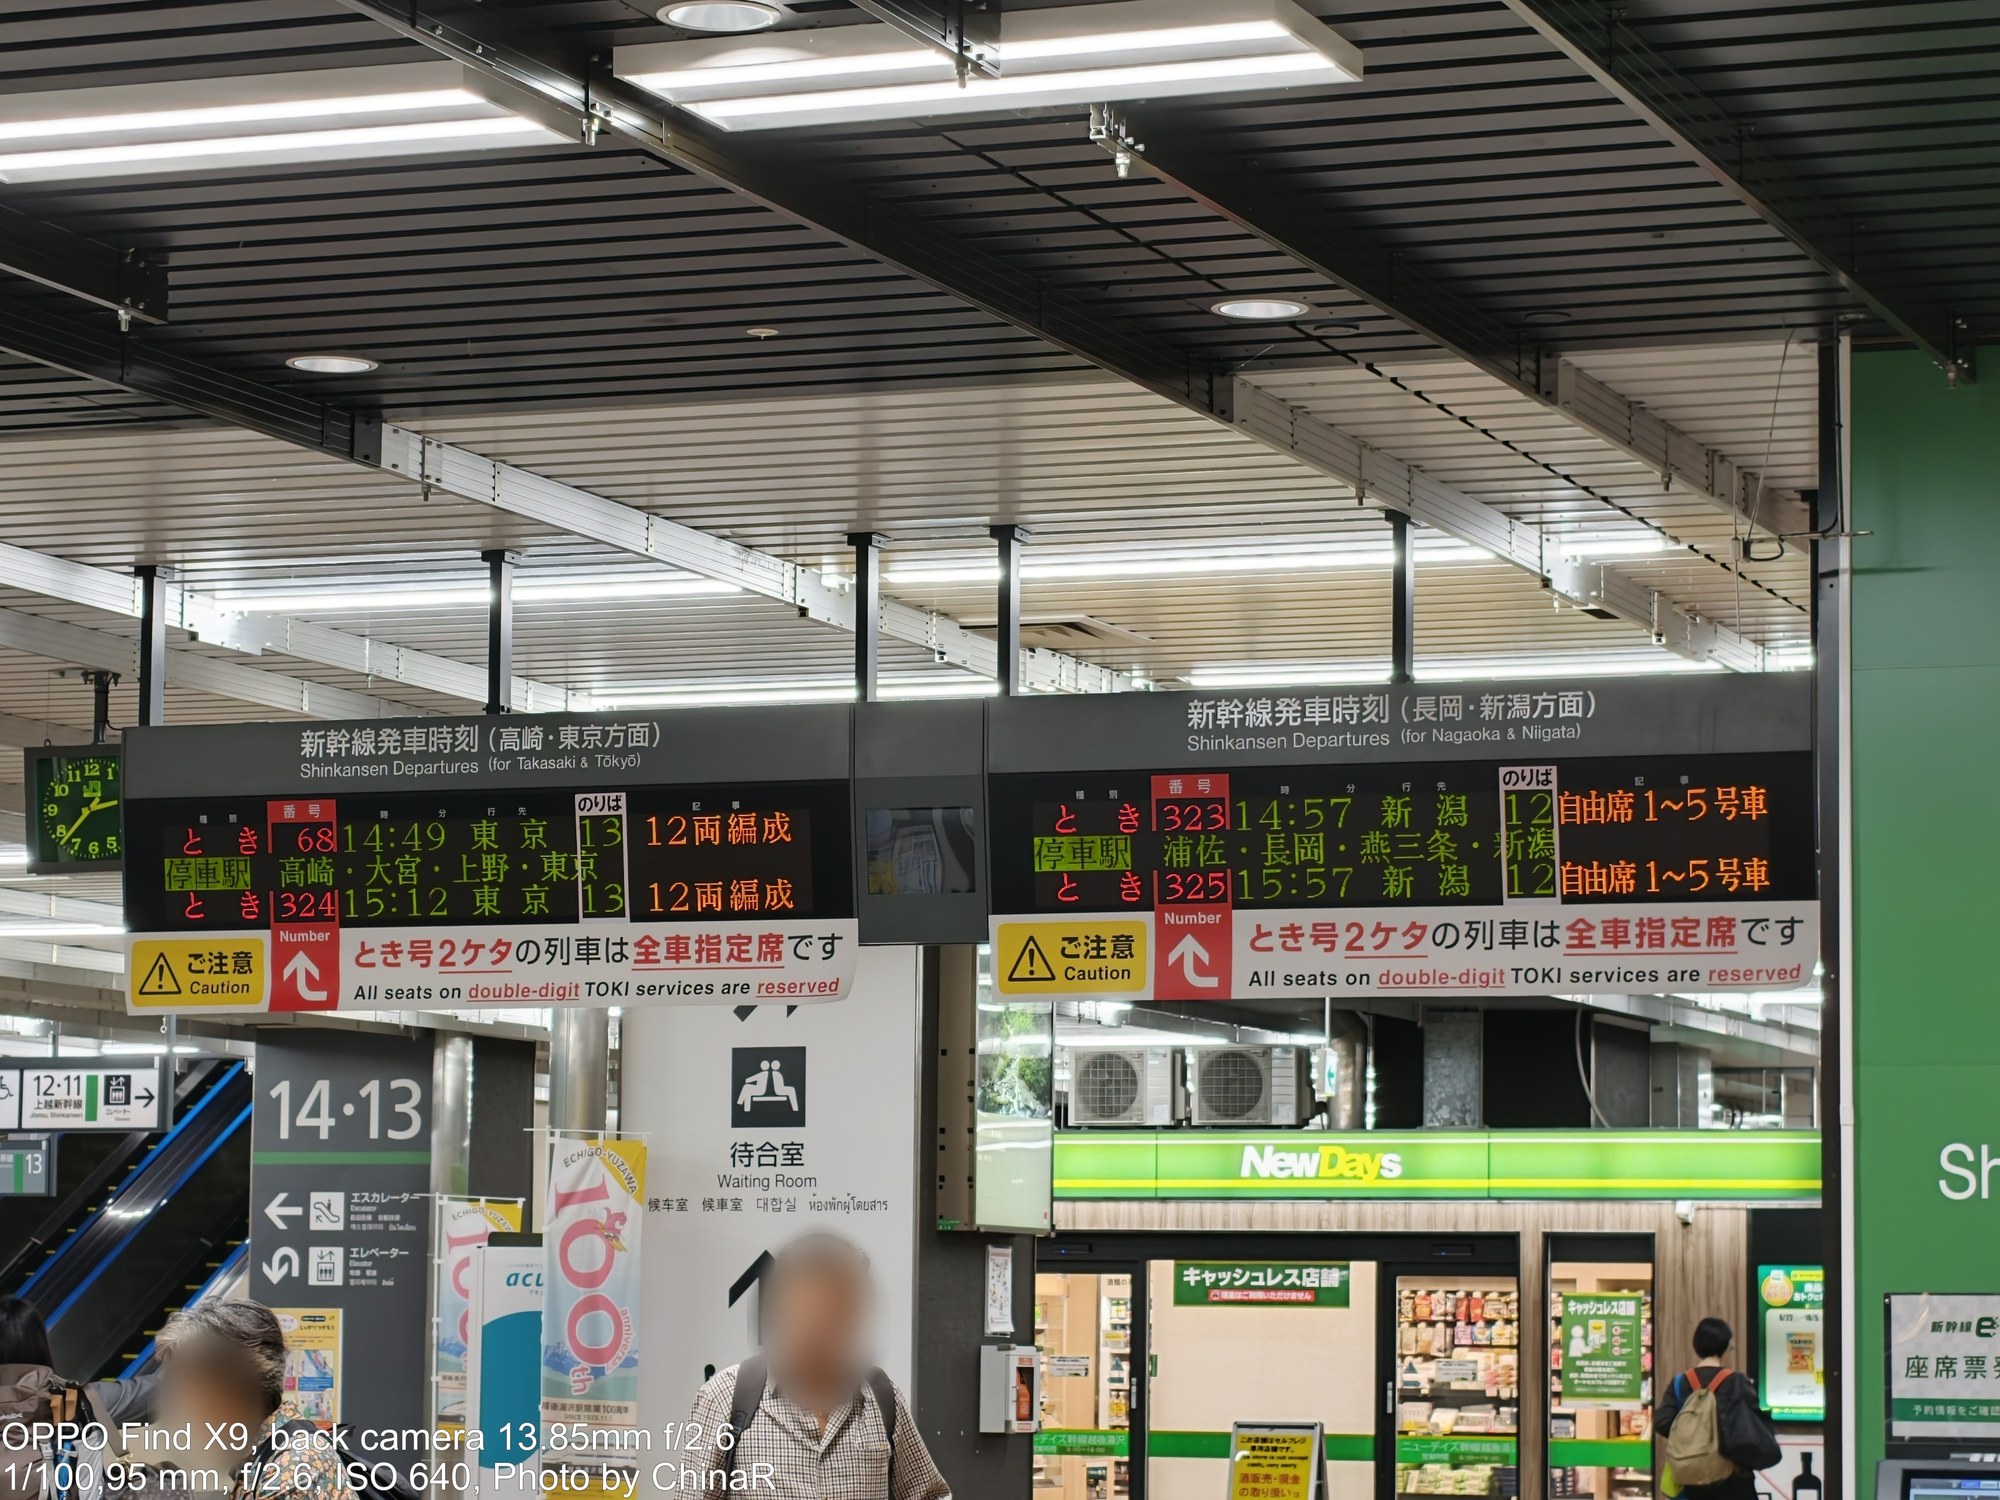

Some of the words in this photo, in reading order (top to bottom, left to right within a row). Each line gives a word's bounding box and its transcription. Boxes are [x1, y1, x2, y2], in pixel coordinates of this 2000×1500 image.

[1188, 694, 1389, 729] 新幹線発車時刻
[301, 724, 478, 758] 新幹線発車時刻
[1188, 735, 1287, 751] Shinkansen
[1293, 732, 1389, 750] Departures
[1401, 729, 1426, 744] (for
[1432, 727, 1501, 744] Nagaoka
[1507, 727, 1515, 740] &
[1522, 725, 1582, 742] Niigata)
[84, 763, 100, 776] 12
[107, 768, 114, 780] 1
[301, 761, 388, 778] Shinkansen
[393, 759, 478, 777] Departures
[488, 757, 510, 772] (for
[517, 756, 576, 770] Takasaki
[580, 757, 588, 768] &
[595, 753, 641, 771] Tōkyō)
[67, 770, 81, 782] 11
[1503, 768, 1552, 786] のりば
[54, 784, 69, 797] 10
[47, 804, 58, 817] 9
[578, 795, 622, 812] のりば
[1163, 804, 1225, 831] 323
[1236, 798, 1352, 831] 14:57
[1506, 793, 1552, 825] 12
[56, 824, 66, 837] 8
[297, 827, 334, 853] 68
[343, 822, 446, 853] 14:49
[580, 818, 622, 848] 13
[646, 811, 792, 846] 12両編成
[71, 838, 82, 850] 7
[88, 841, 99, 854] 6
[106, 836, 117, 849] 5
[1035, 837, 1130, 871] 停車駅
[166, 857, 250, 890] 停車駅
[1165, 873, 1226, 900] 325
[1238, 867, 1353, 900] 15:57
[1508, 863, 1554, 895] 12
[280, 891, 336, 918] 324
[345, 887, 448, 918] 15:12
[582, 883, 624, 913] 13
[649, 879, 795, 912] 12両編成
[1164, 912, 1222, 925] Number
[279, 930, 331, 943] Number
[1060, 934, 1135, 960] ご注意
[187, 951, 254, 976] ご注意
[1064, 966, 1131, 981] Caution
[1249, 970, 1275, 987] All
[1282, 971, 1337, 986] seats
[1346, 973, 1371, 985] on
[1378, 968, 1505, 989] double-digit
[1511, 967, 1562, 984] TOKI
[1570, 967, 1660, 983] services
[1668, 969, 1701, 983] are
[1709, 963, 1802, 983] reserved
[190, 980, 250, 995] Caution
[354, 985, 377, 1000] All
[384, 985, 432, 1000] seats
[439, 987, 462, 999] on
[468, 981, 580, 1001] double-digit
[585, 981, 629, 998] TOKI
[636, 981, 715, 996] services
[721, 982, 751, 995] are
[757, 977, 840, 995] reserved
[25, 1154, 42, 1174] 13
[730, 1141, 805, 1168] 待合室
[1240, 1145, 1402, 1183] NewDays
[562, 1146, 638, 1195] ECHIGO-YUZAWA
[717, 1174, 771, 1191] Waiting
[775, 1174, 817, 1188] Room
[351, 1191, 420, 1204] エスカレーター
[756, 1197, 797, 1213] 대합실
[349, 1247, 409, 1259] エレベーター
[1182, 1267, 1341, 1288] キャッシュレス店舗
[1905, 1355, 2000, 1379] 座席票
